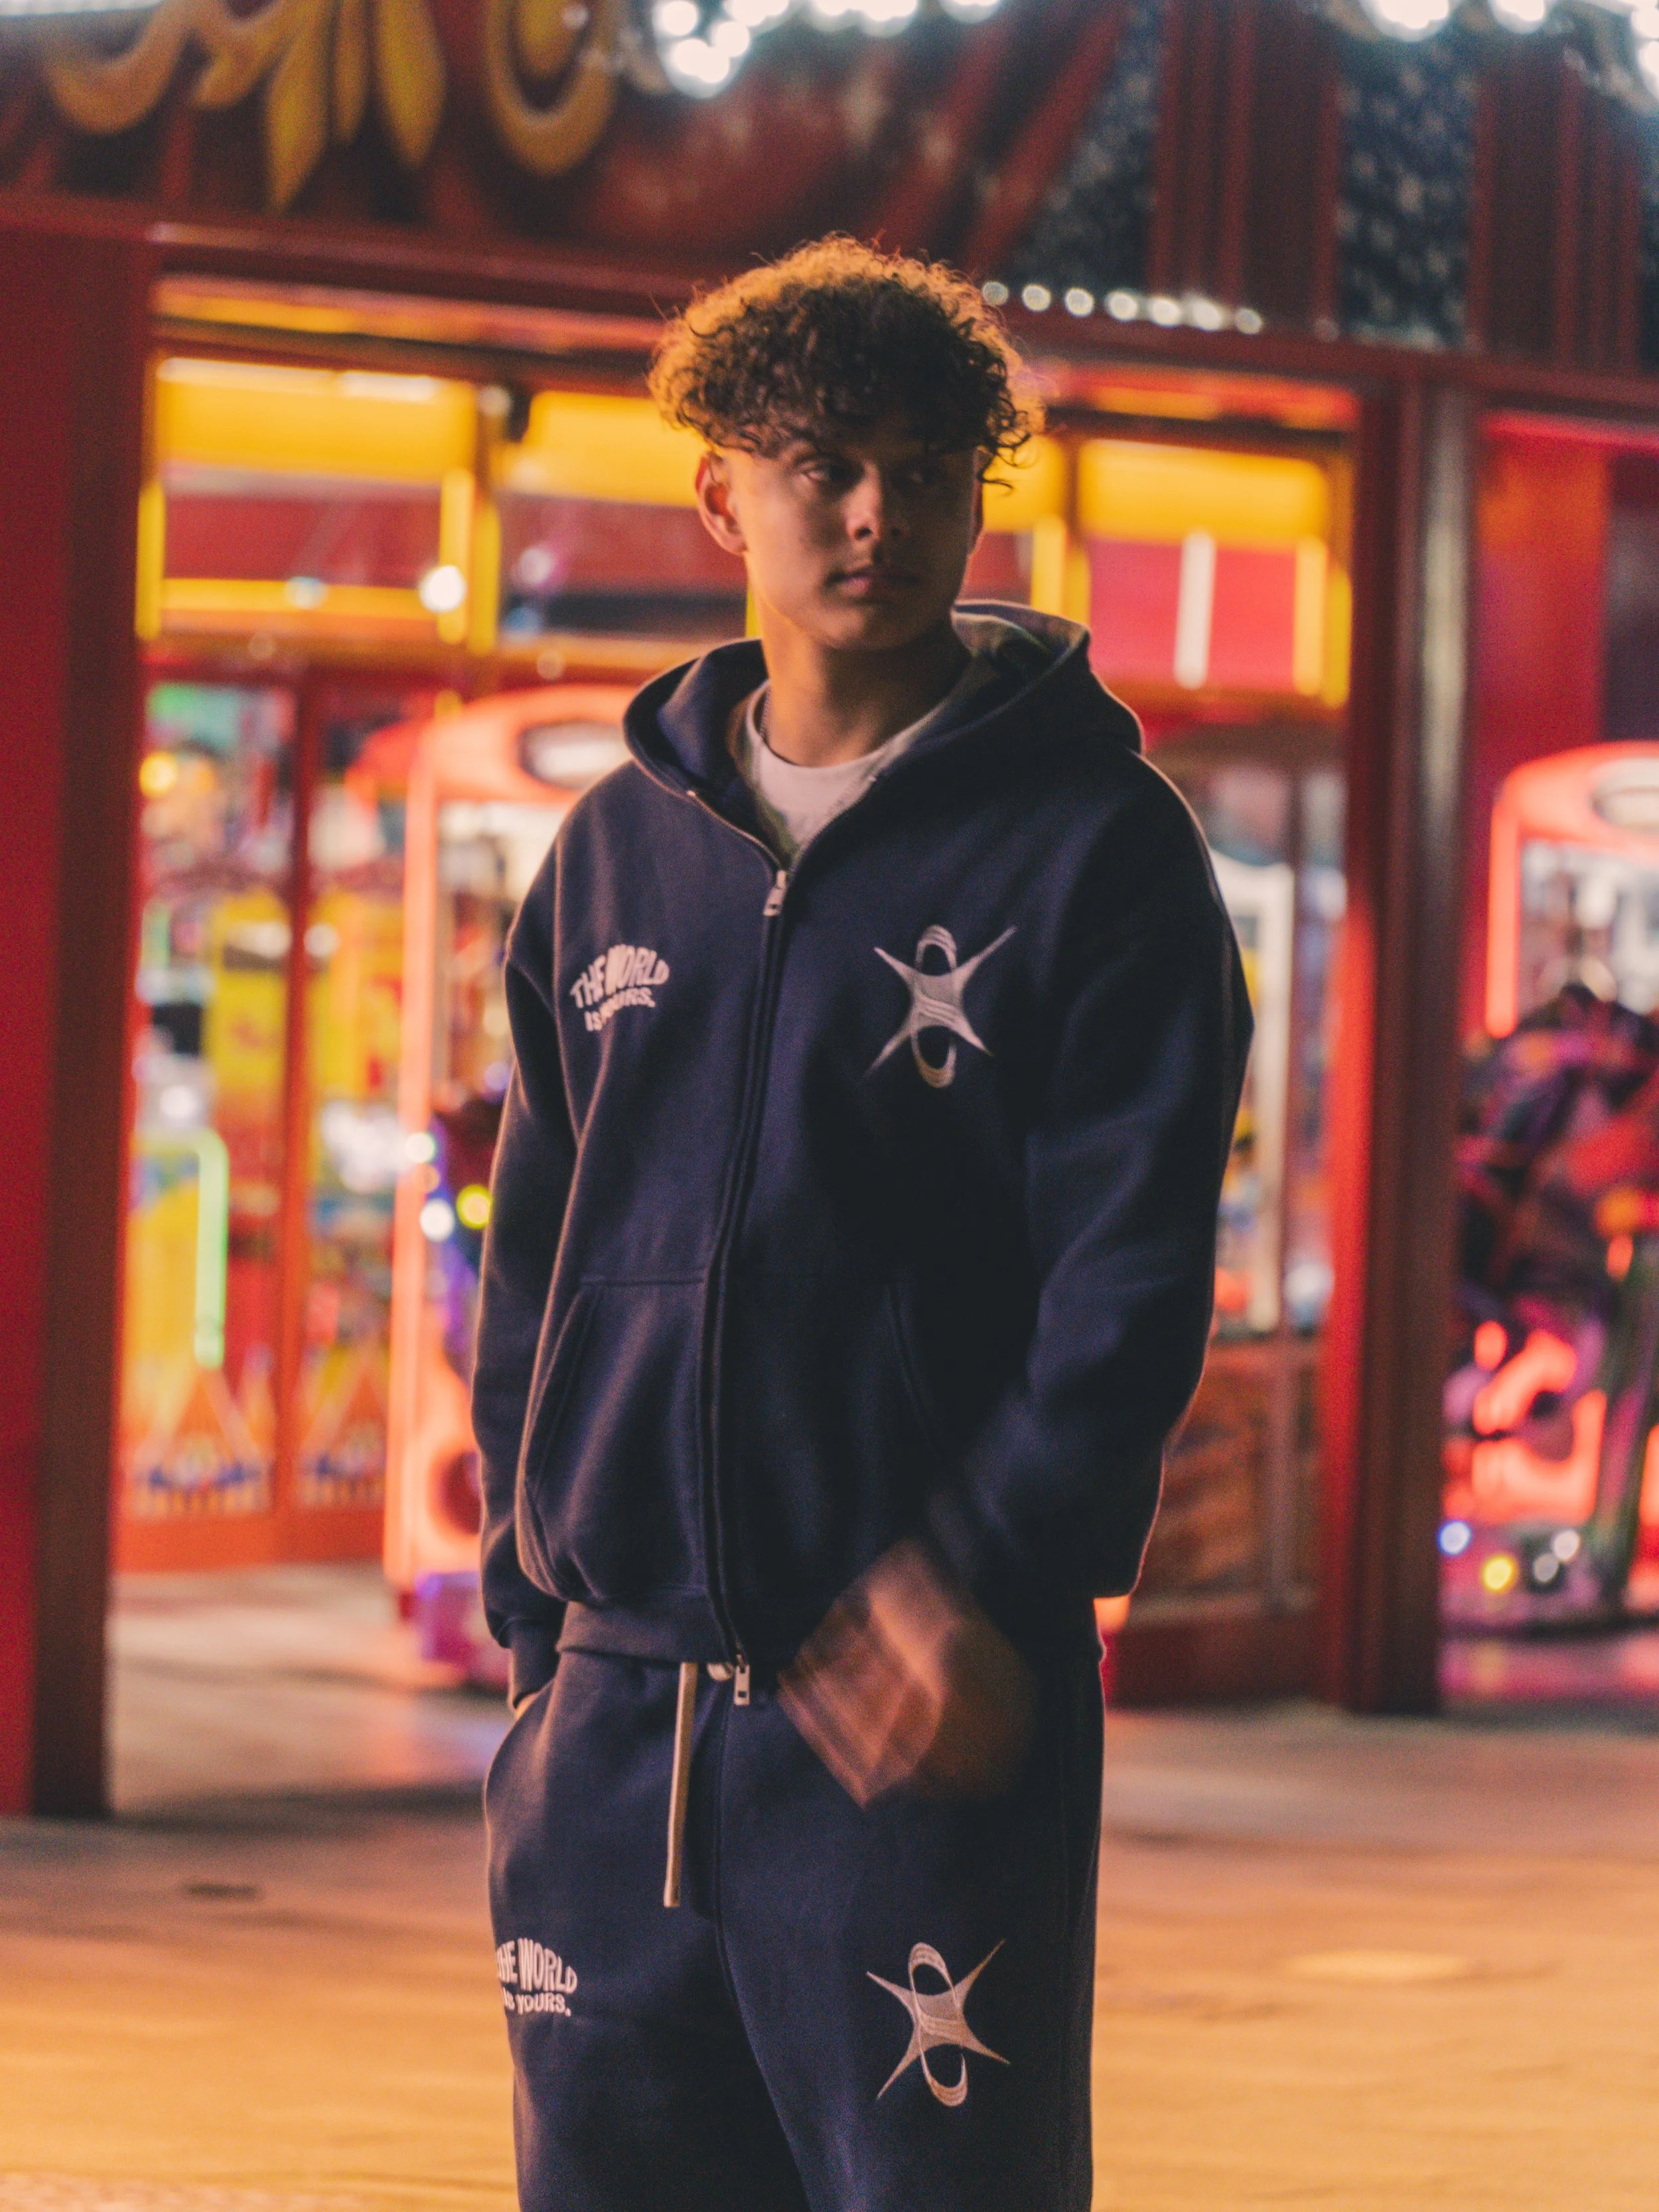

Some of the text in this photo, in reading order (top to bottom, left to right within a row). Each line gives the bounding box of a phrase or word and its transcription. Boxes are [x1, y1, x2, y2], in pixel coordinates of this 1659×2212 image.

[570, 944, 670, 1008] THE WORLD
[585, 1011, 603, 1031] IS
[518, 1938, 578, 1994] WORLD
[515, 1992, 571, 2017] YOURS.
